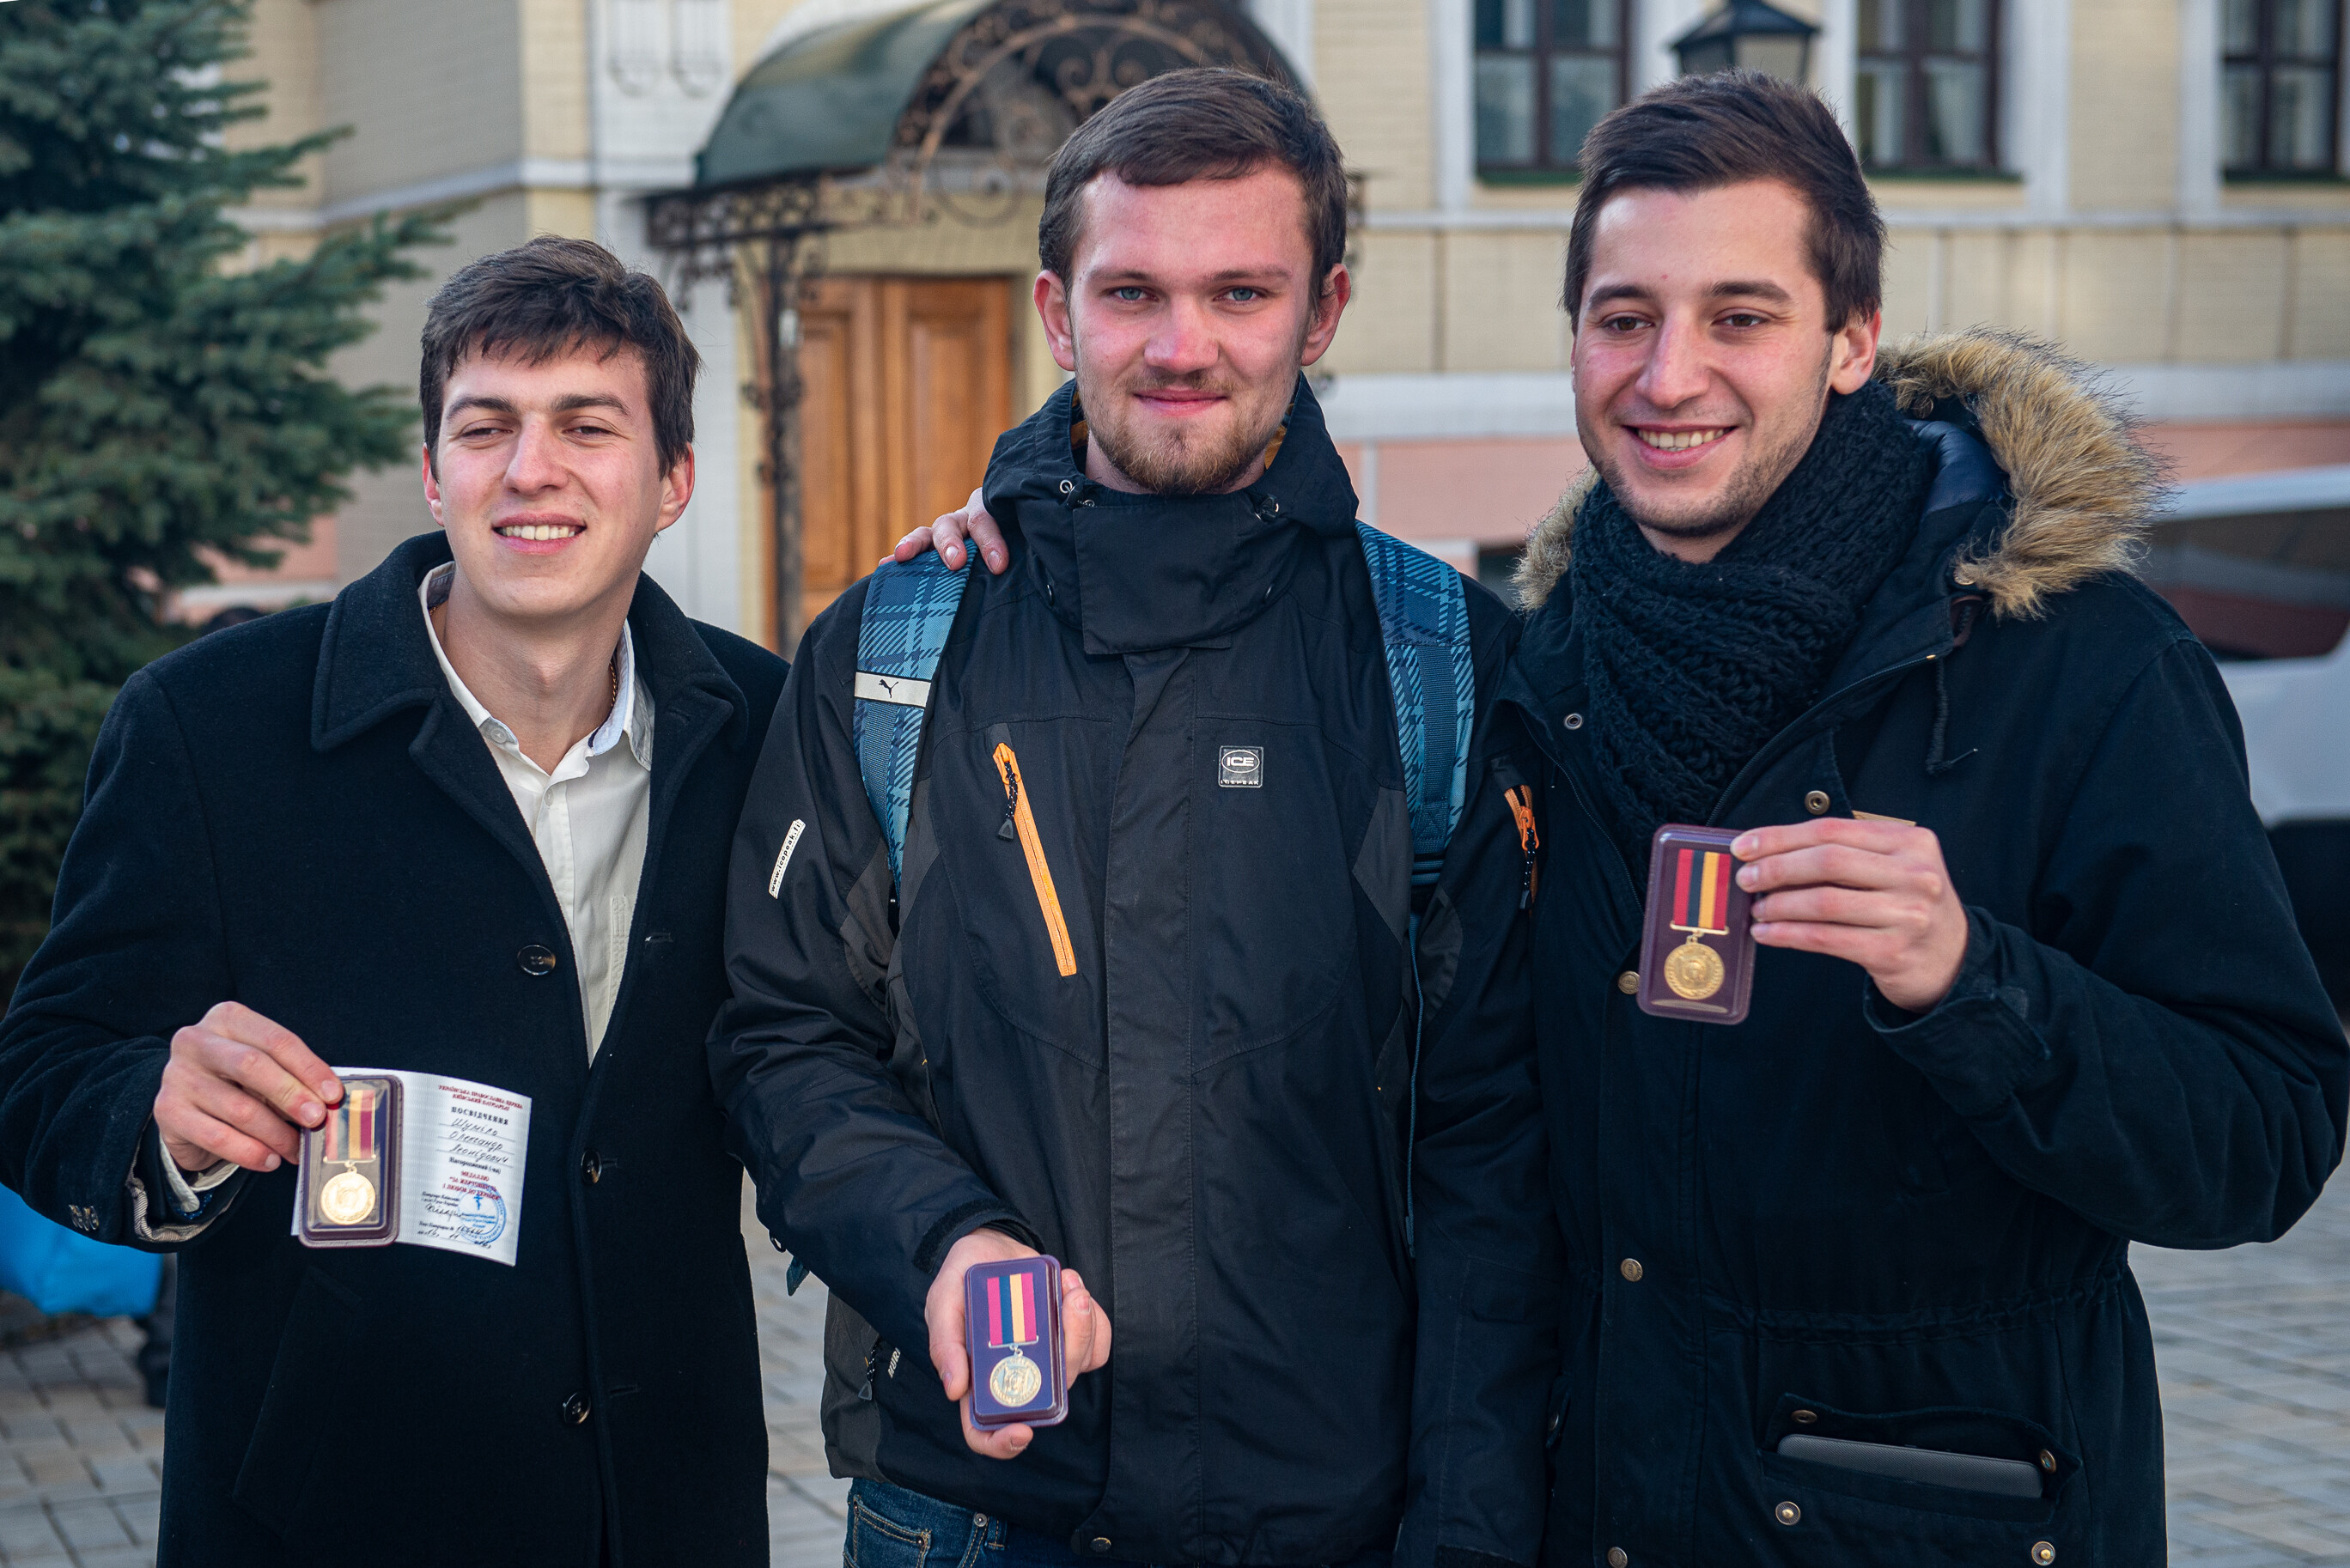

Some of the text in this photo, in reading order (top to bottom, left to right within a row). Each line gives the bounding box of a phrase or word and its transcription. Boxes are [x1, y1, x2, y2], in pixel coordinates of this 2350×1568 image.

[1227, 757, 1255, 767] ICE
[771, 822, 801, 892] www.icepeak.fi
[451, 1106, 508, 1125] ПОСВІДЧЕННЯ
